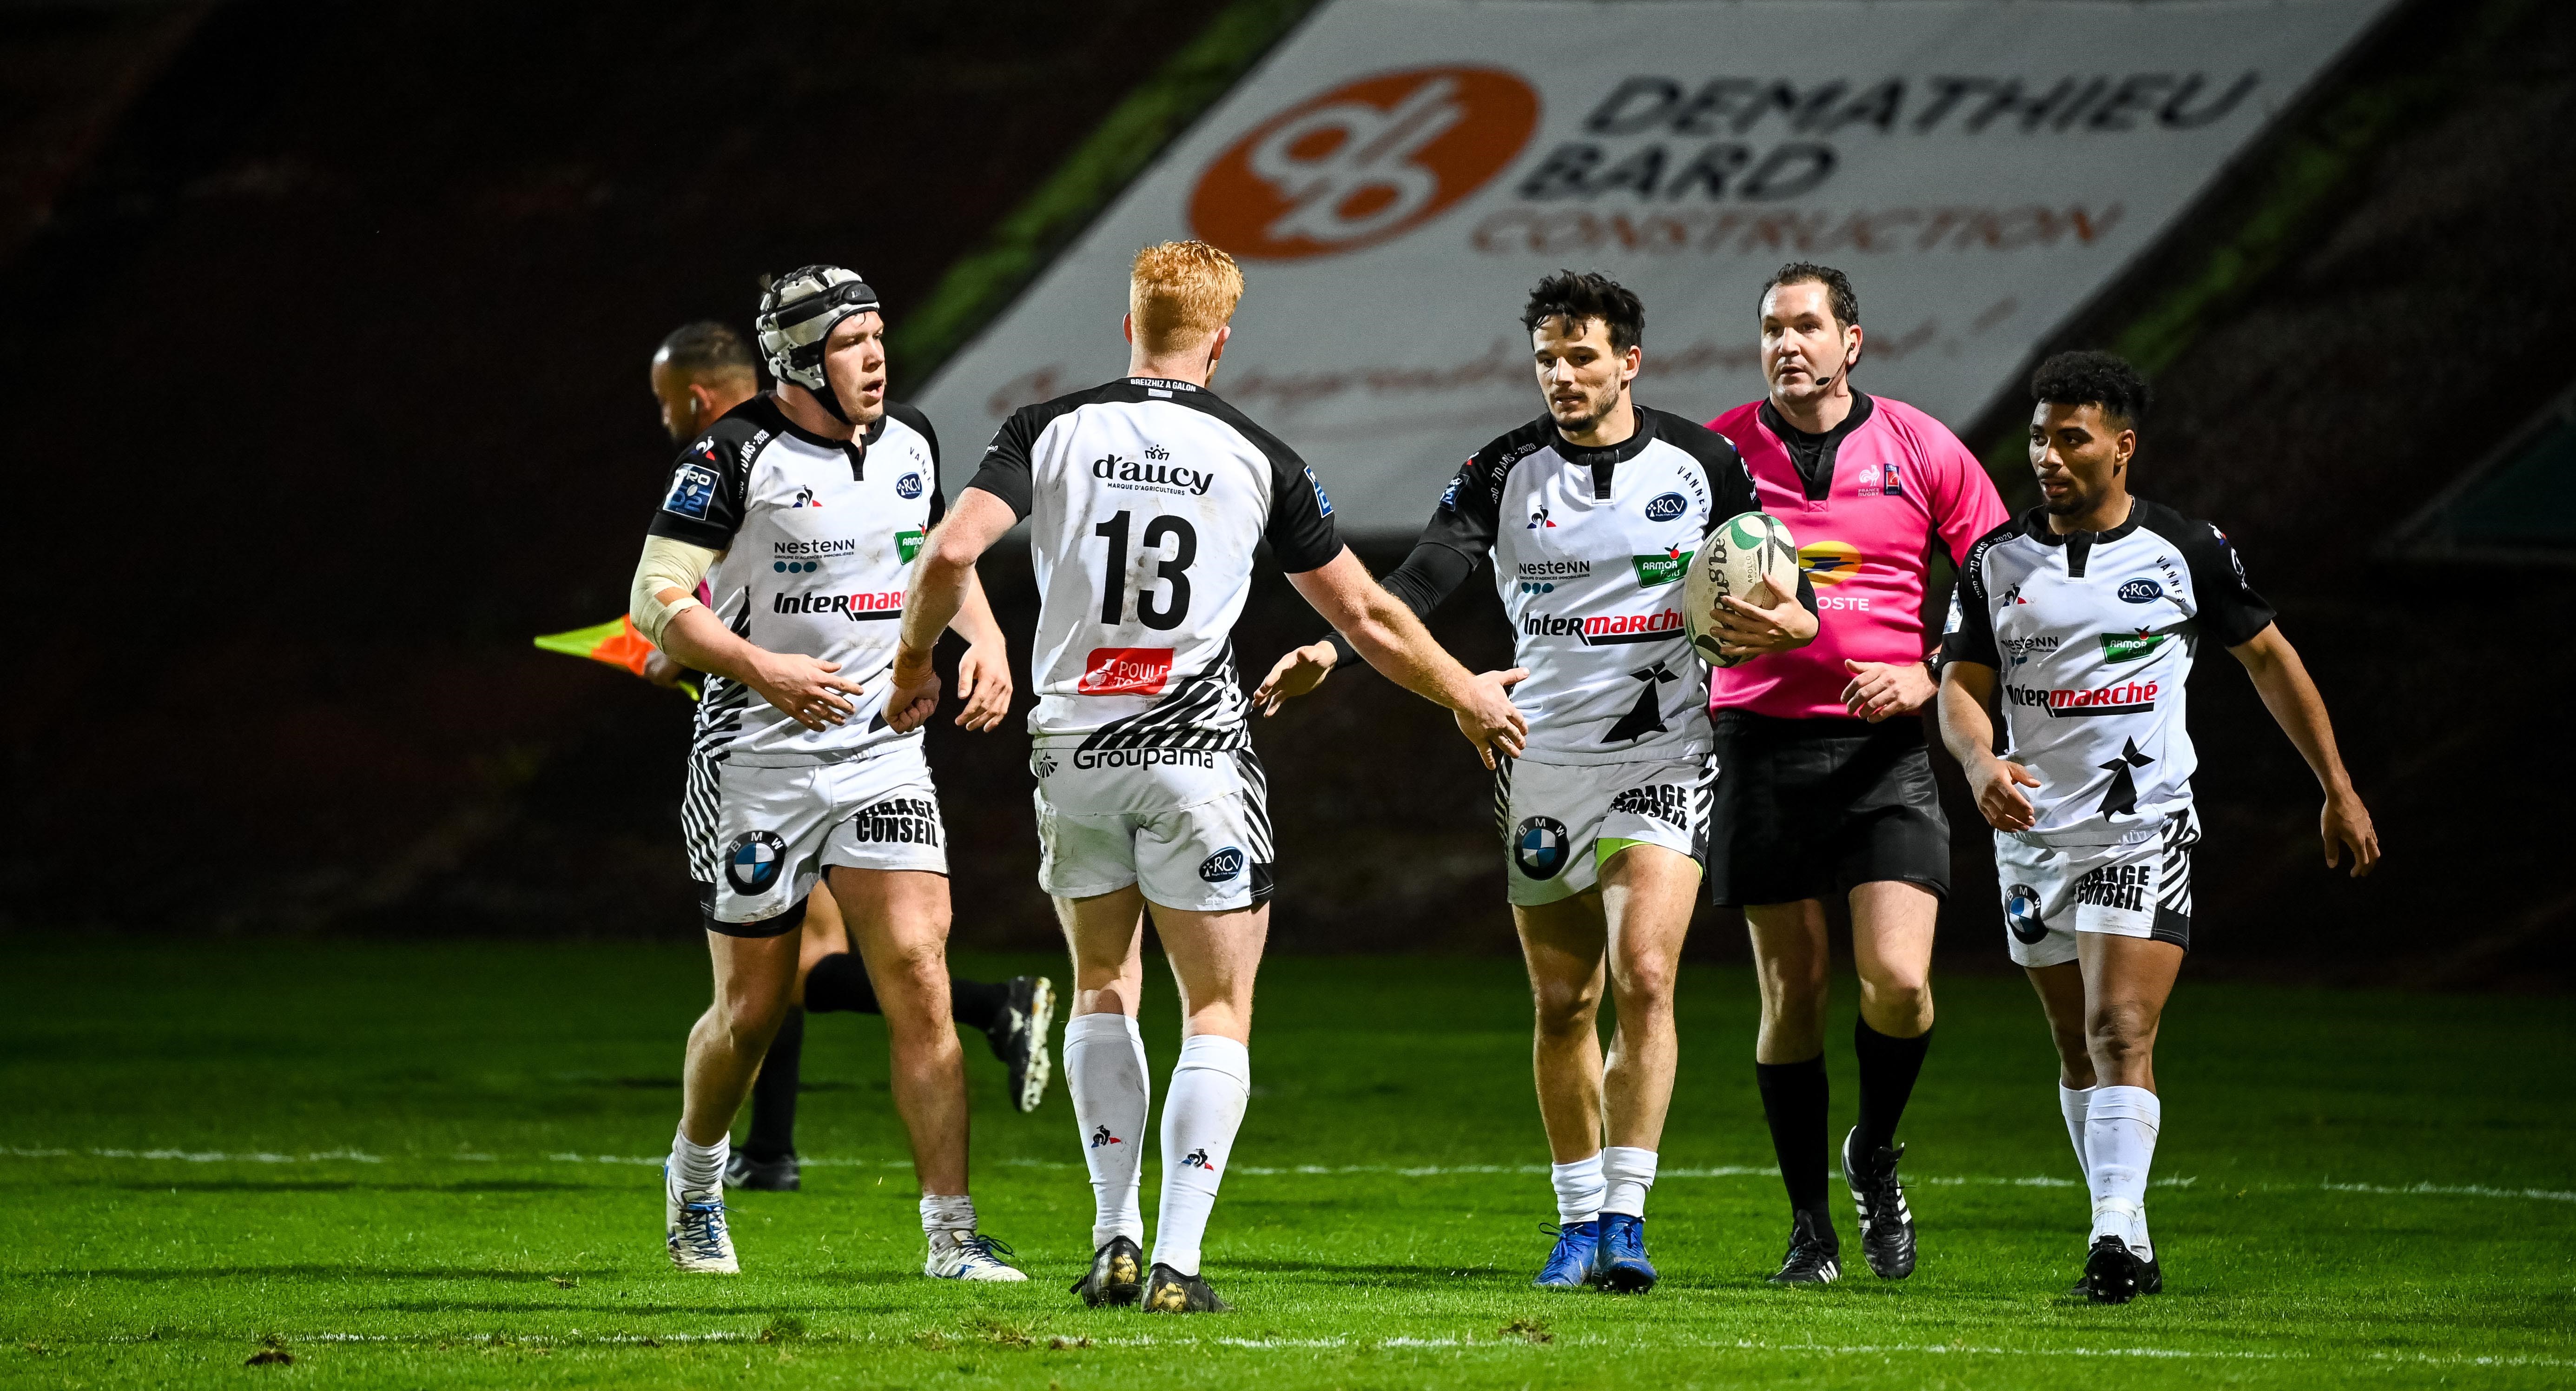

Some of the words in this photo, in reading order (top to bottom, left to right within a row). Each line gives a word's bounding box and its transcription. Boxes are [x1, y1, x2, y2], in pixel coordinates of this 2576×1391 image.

[1584, 71, 2260, 136] DEMATHIEU
[1519, 143, 1840, 202] BARD
[1470, 204, 2124, 256] CONSTRUCTION
[1130, 379, 1164, 387] BREIZHIZ
[1172, 382, 1196, 392] GALON
[1491, 467, 1505, 482] 70
[1499, 454, 1515, 470] ANS
[1518, 443, 1536, 454] 2020
[1093, 454, 1214, 496] d'aucy
[903, 477, 920, 493] RCV
[1135, 485, 1185, 496] D'AGRICULTEURS
[1657, 499, 1684, 513] RCV
[902, 537, 925, 546] ARMO
[1994, 532, 2013, 543] 2020
[1974, 542, 1988, 560] ANS
[1095, 510, 1197, 631] 13
[1643, 560, 1678, 570] ARMOR
[1970, 560, 1980, 573] 70
[2156, 555, 2186, 603] VANNES
[2131, 583, 2160, 597] RCV
[1816, 596, 1869, 611] OSTE
[1073, 748, 1213, 771] Groupama
[856, 817, 938, 848] CONSEIL
[1518, 818, 1565, 836] BMW
[731, 831, 784, 853] BMW
[1214, 854, 1241, 873] RCV
[2006, 886, 2041, 910] BMW
[2077, 881, 2143, 912] CONSEIL
